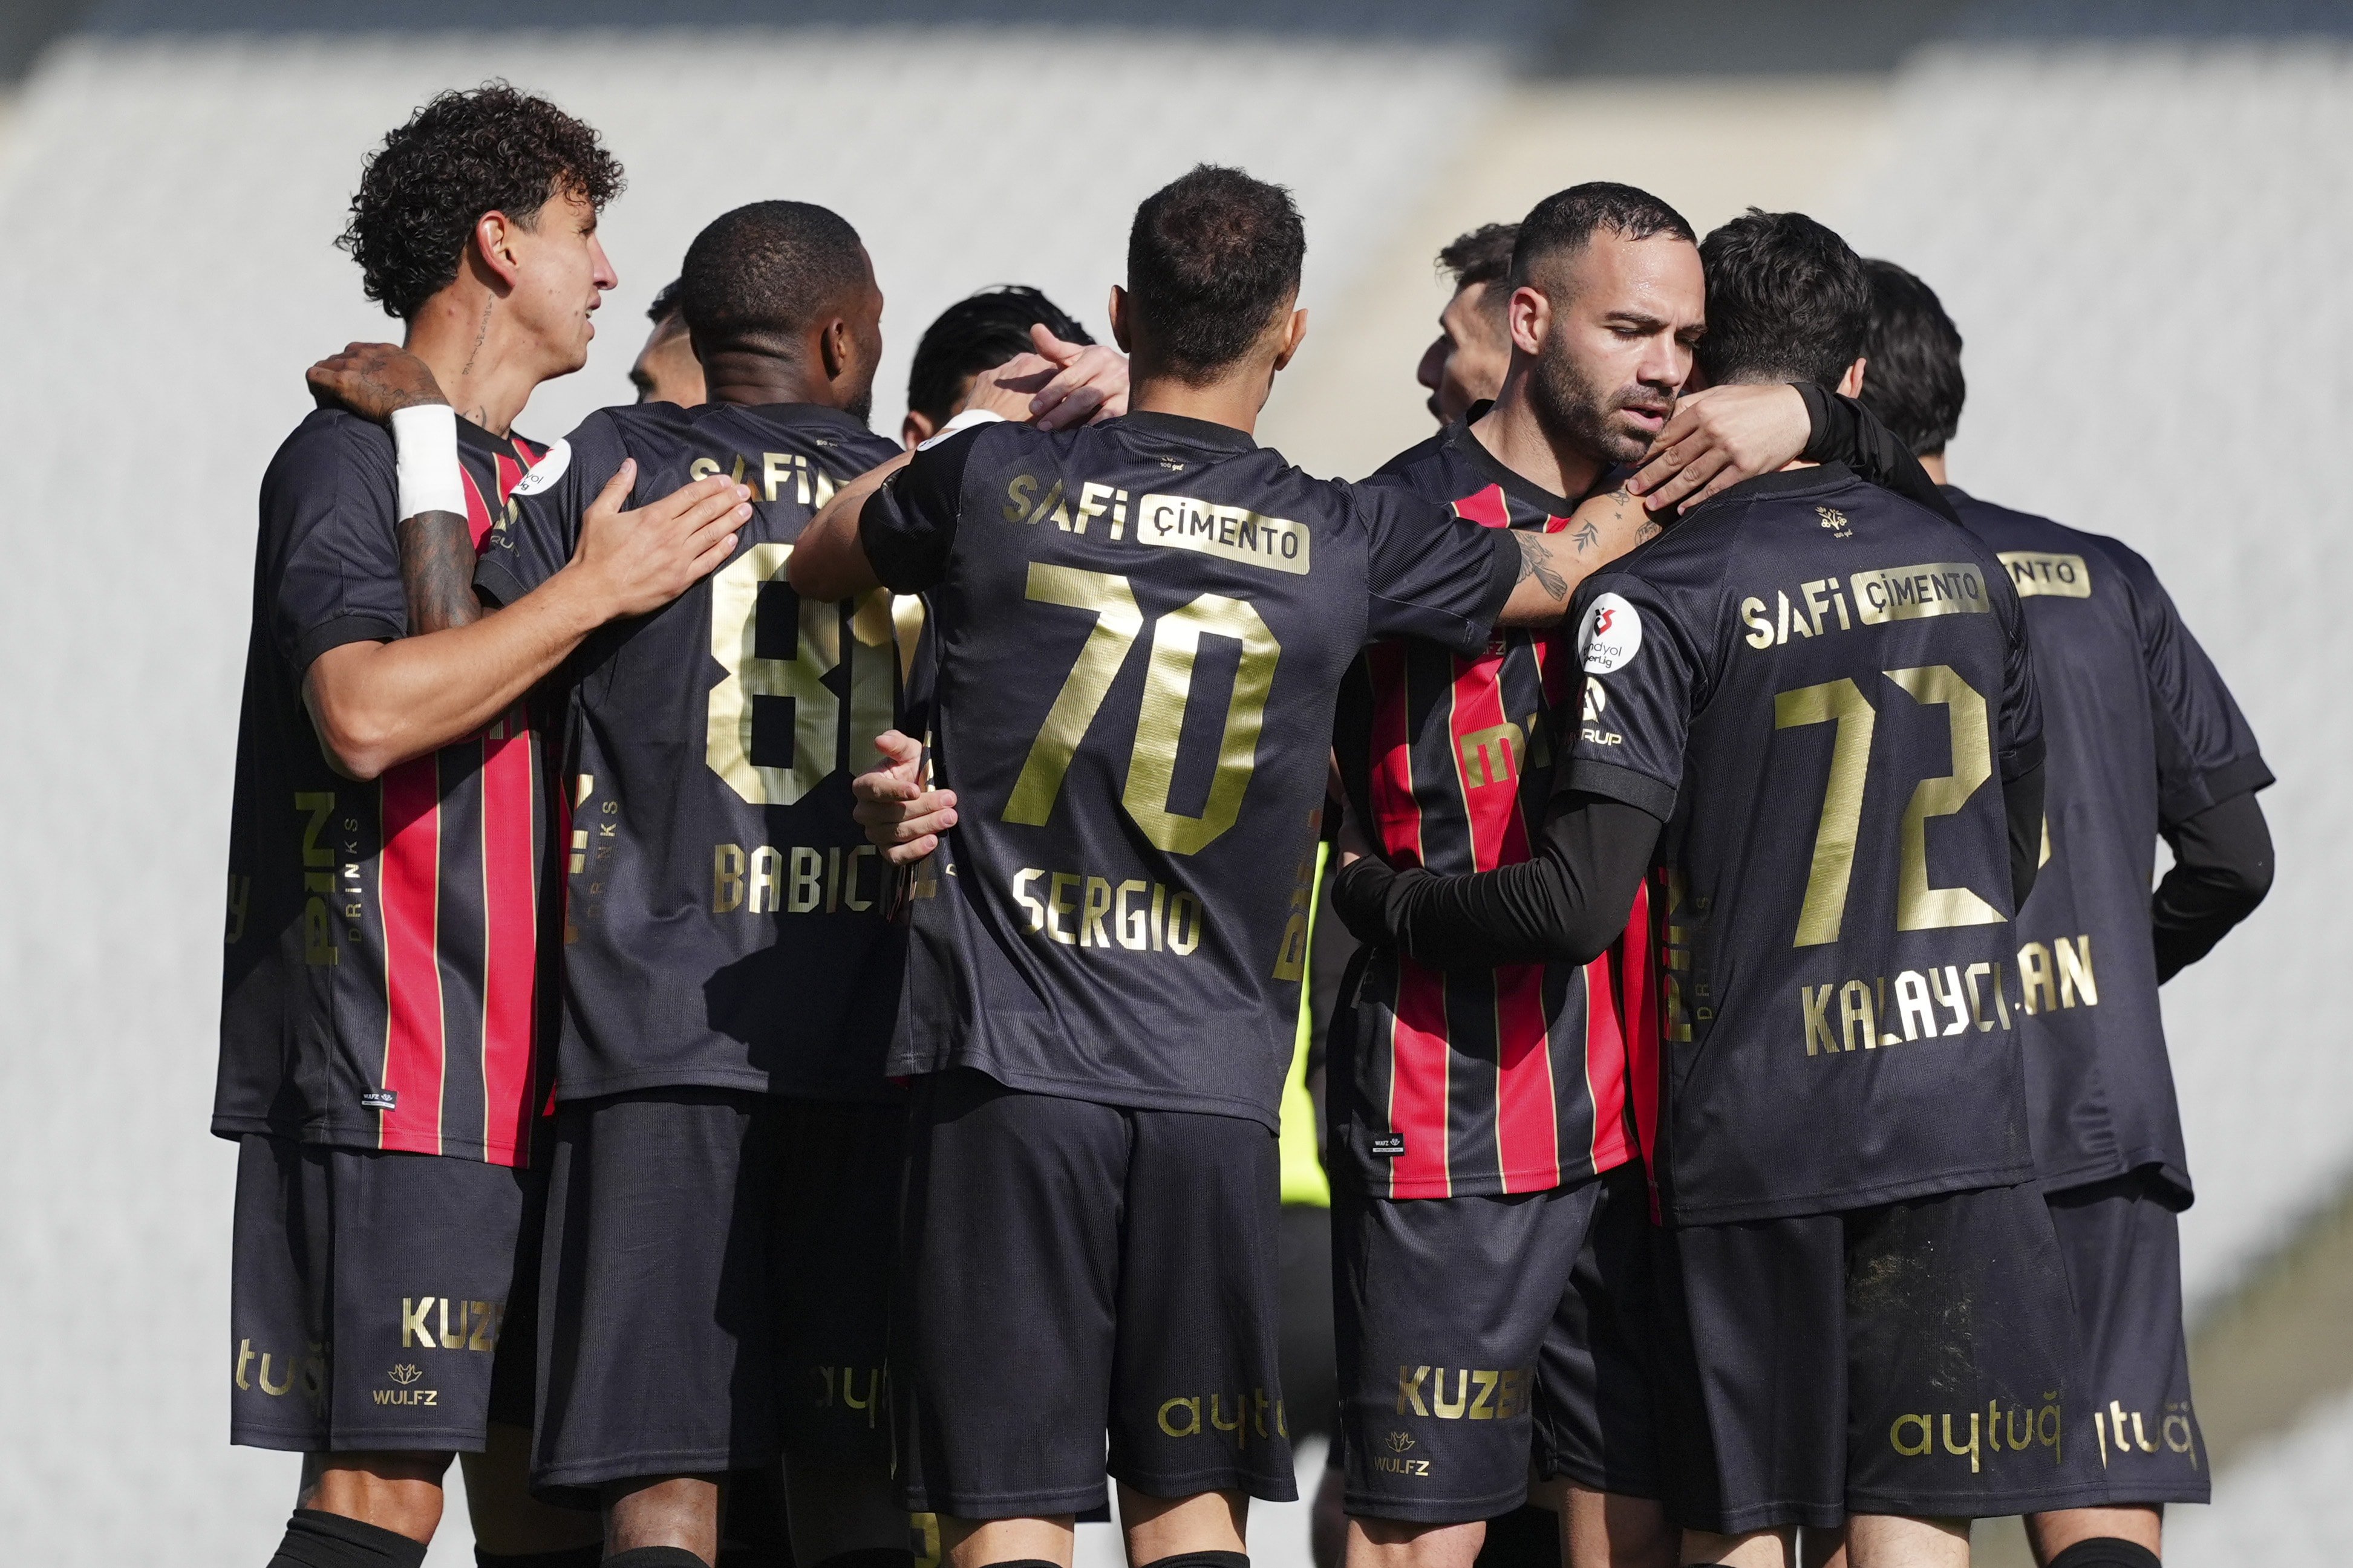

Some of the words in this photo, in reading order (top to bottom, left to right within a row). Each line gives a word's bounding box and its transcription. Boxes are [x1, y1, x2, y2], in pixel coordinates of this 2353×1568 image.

[1154, 503, 1298, 559] ÇİMENTO
[1865, 572, 1979, 614] ÇİMENTO
[2003, 561, 2075, 584] NTO
[1000, 561, 1281, 856] 70
[1775, 665, 2008, 947] 72
[344, 818, 362, 943] DRINKS
[1012, 867, 1203, 956] SERGIO
[1801, 962, 2011, 1056] KALAYCI
[2015, 934, 2098, 1015] AN
[373, 1390, 437, 1406] WULFZ
[1890, 1391, 2061, 1473] aytuğ
[1374, 1456, 1429, 1477] WULFZ
